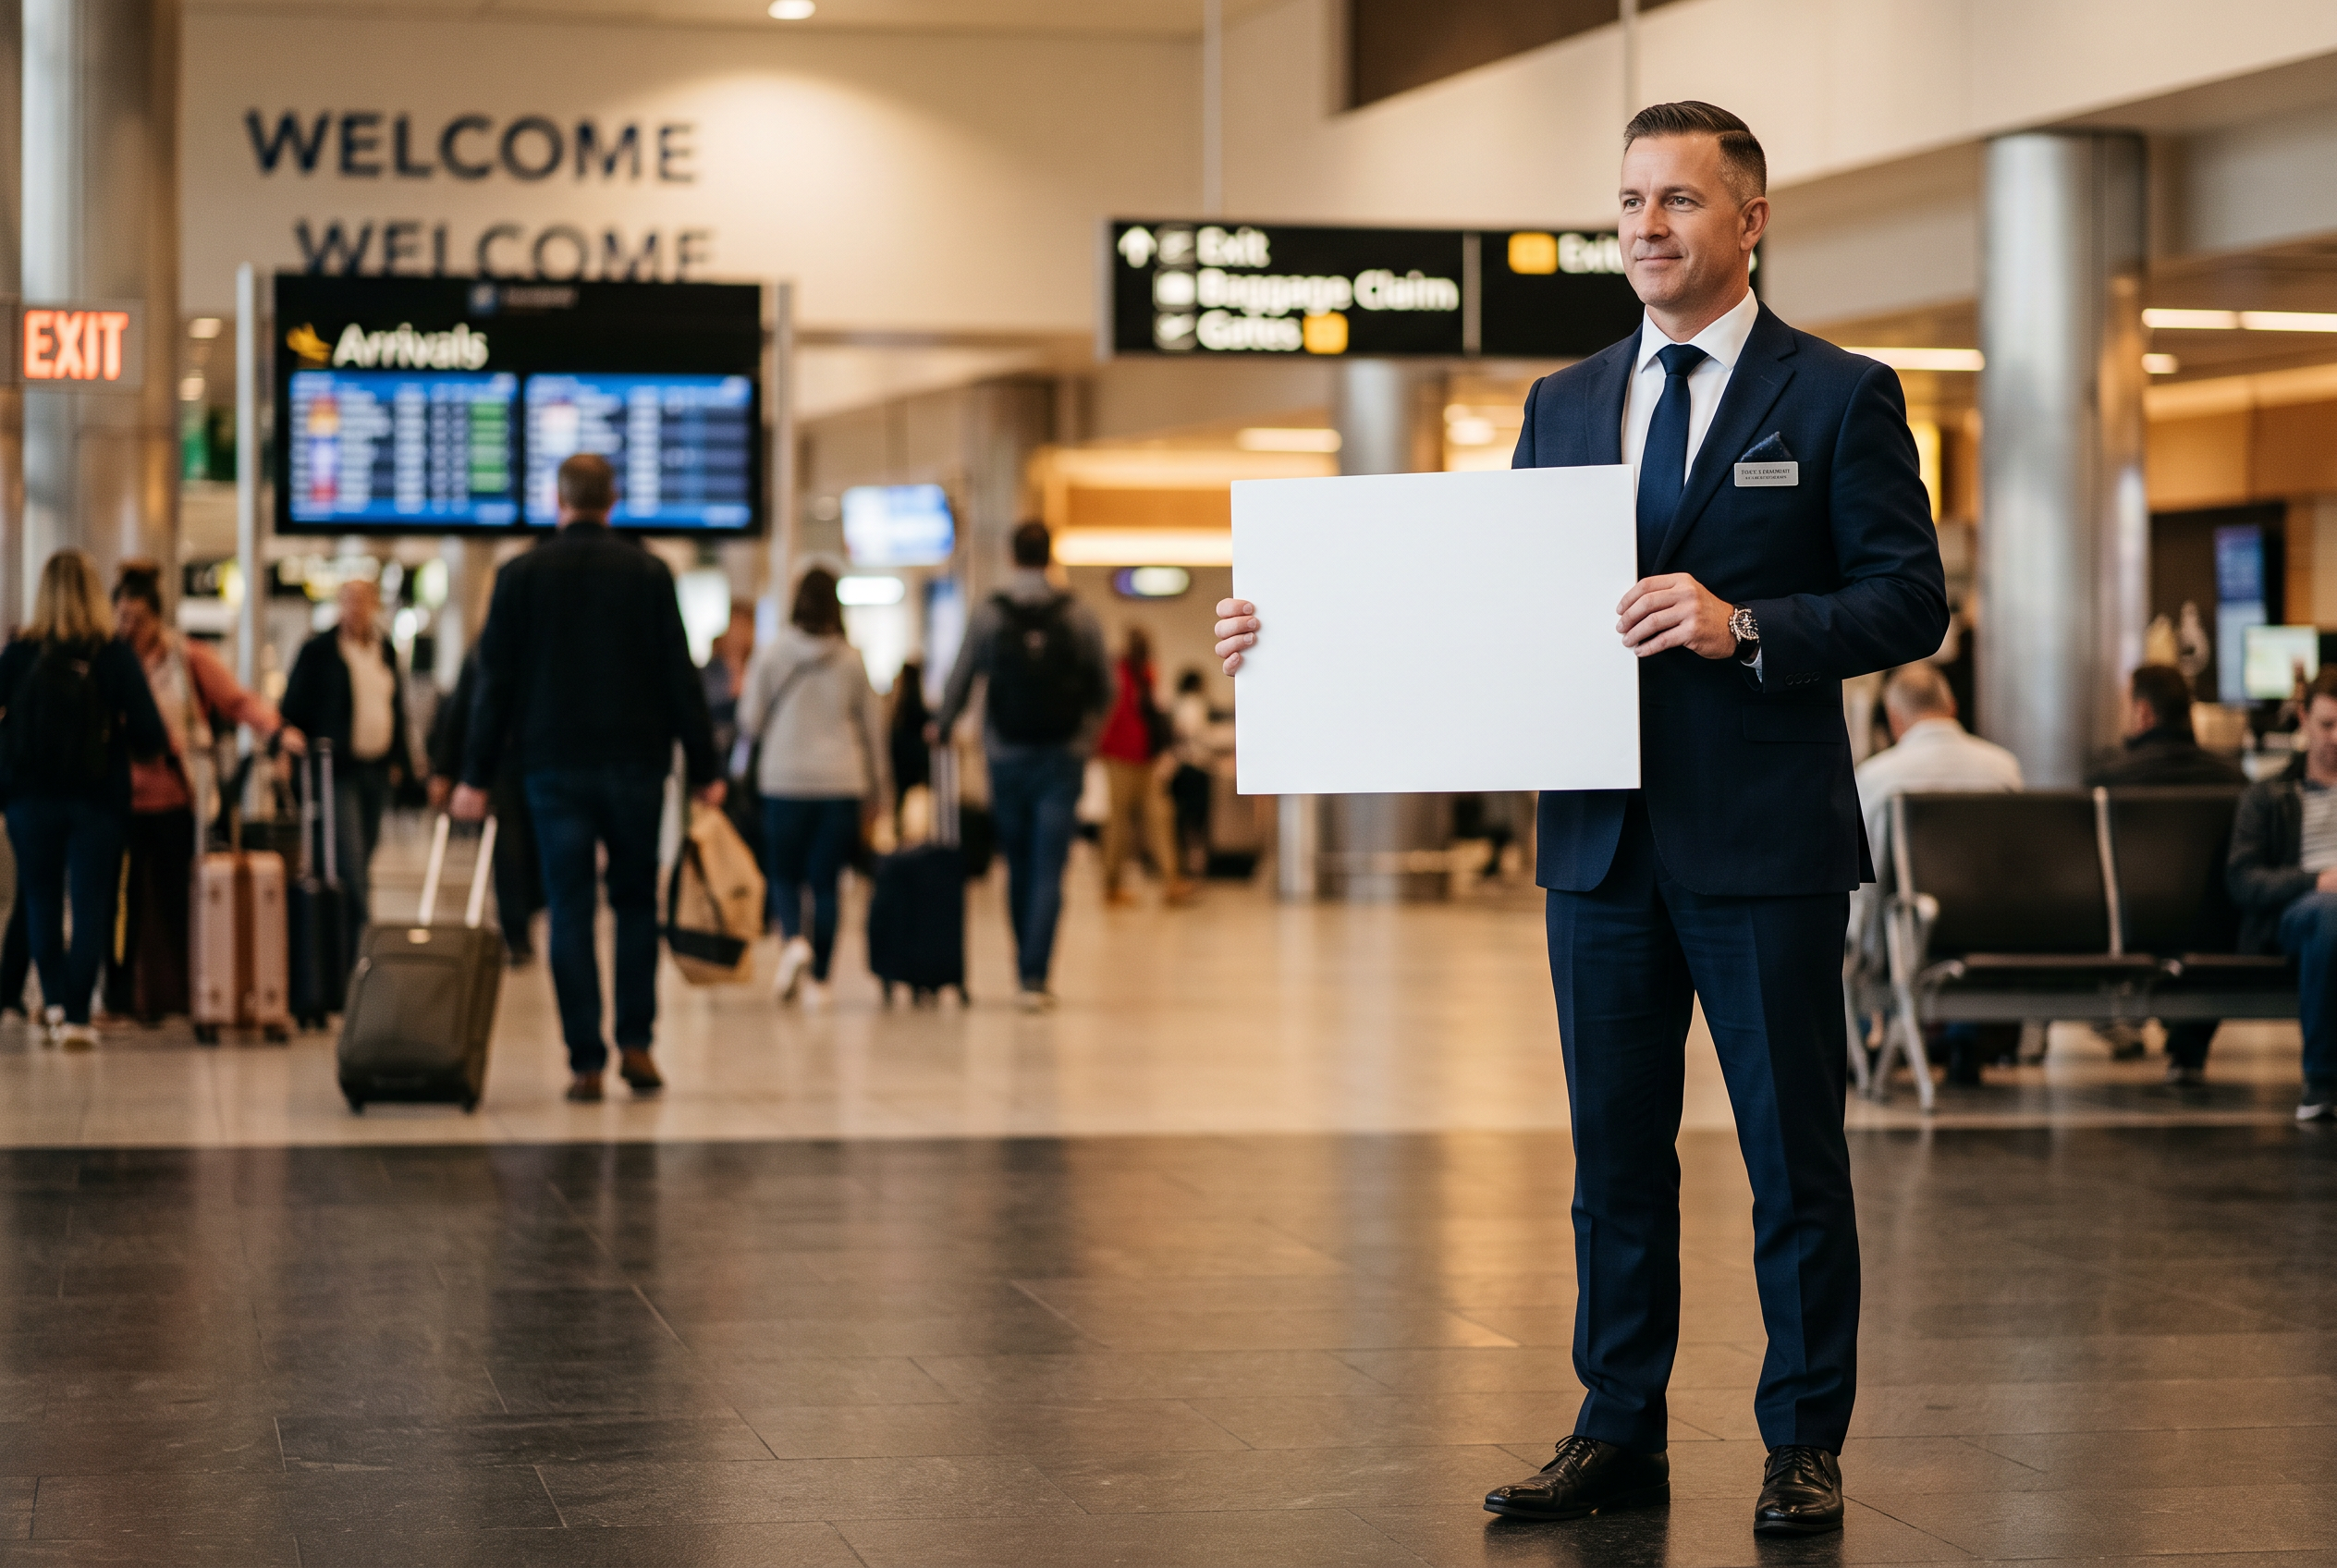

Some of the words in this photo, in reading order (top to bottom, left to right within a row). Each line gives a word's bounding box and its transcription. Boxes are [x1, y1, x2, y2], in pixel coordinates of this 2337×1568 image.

[244, 108, 696, 182] WELCOME
[1197, 226, 1271, 268] Exit
[1197, 267, 1353, 316] Baggage
[1353, 269, 1460, 311] Claim
[24, 310, 129, 380] EXIT
[333, 322, 489, 370] Arrivals
